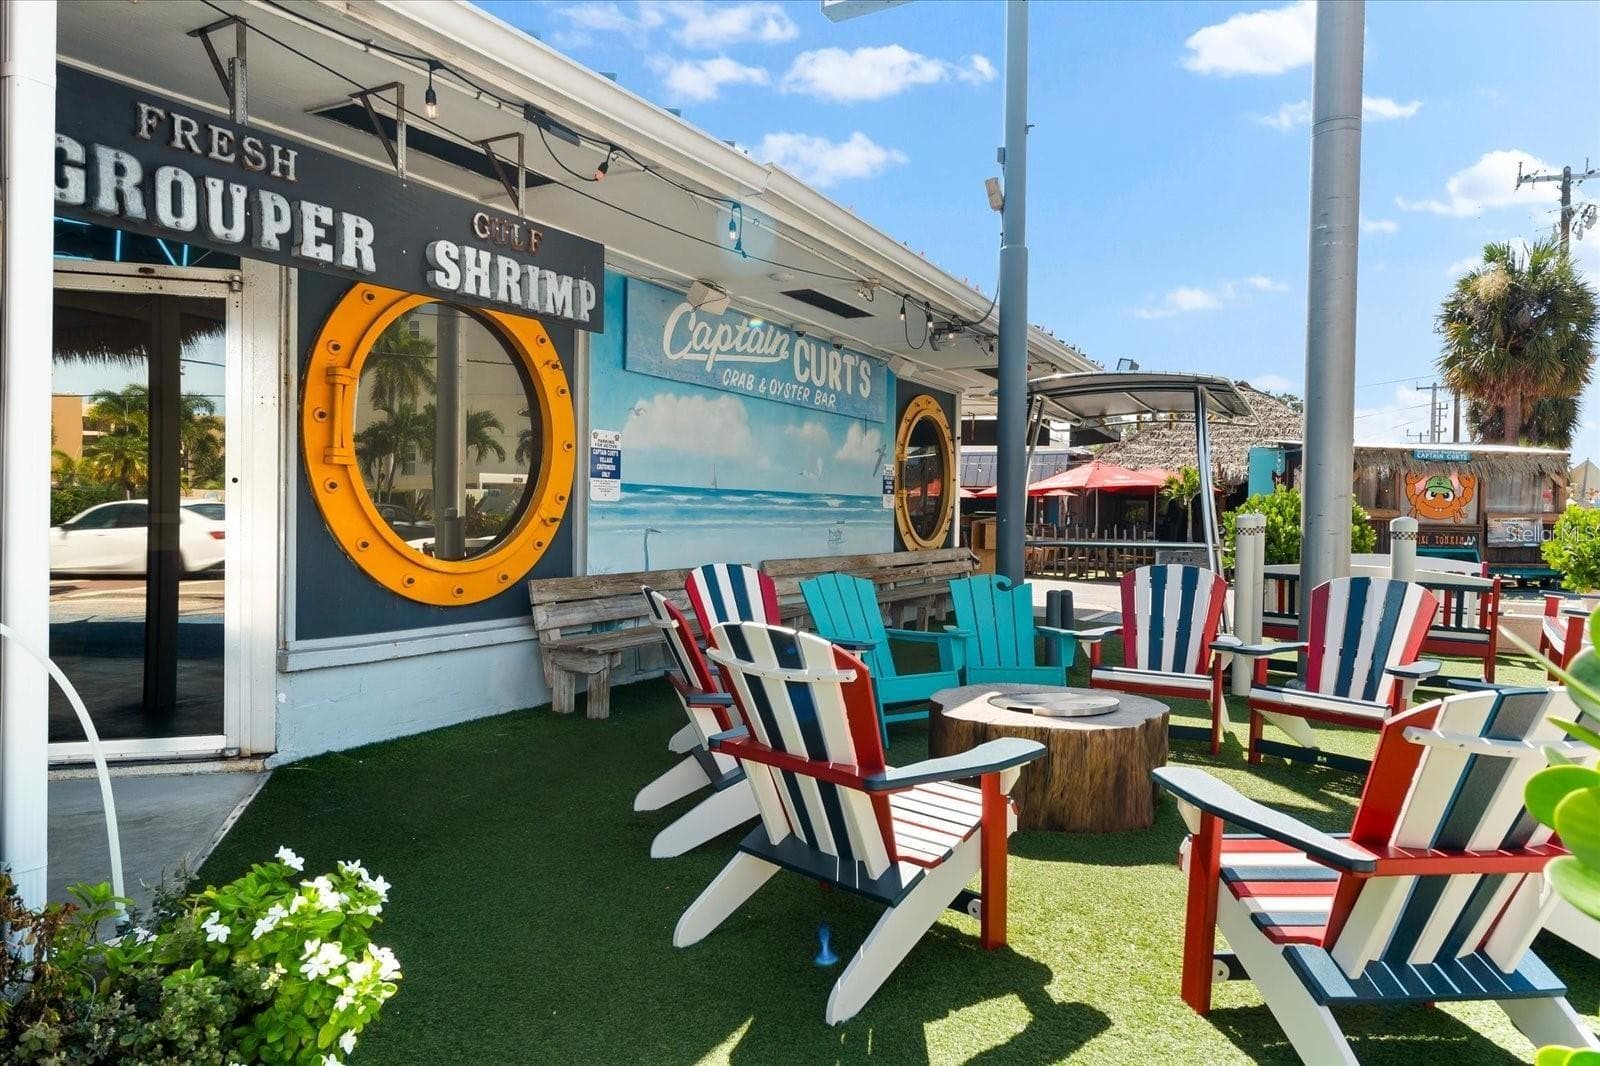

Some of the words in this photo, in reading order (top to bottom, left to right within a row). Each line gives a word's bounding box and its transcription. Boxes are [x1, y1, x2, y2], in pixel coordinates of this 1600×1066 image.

[135, 102, 298, 182] FRESH
[54, 133, 376, 274] GROUPER
[473, 212, 544, 255] GULF
[426, 239, 597, 323] SHRIMP
[662, 302, 790, 372] Captain
[793, 339, 872, 398] CURT'S
[723, 368, 754, 391] CRAB
[759, 378, 768, 394] &
[769, 377, 810, 402] OYSTER
[815, 391, 837, 408] BAR
[1416, 452, 1444, 460] CAPTAIN
